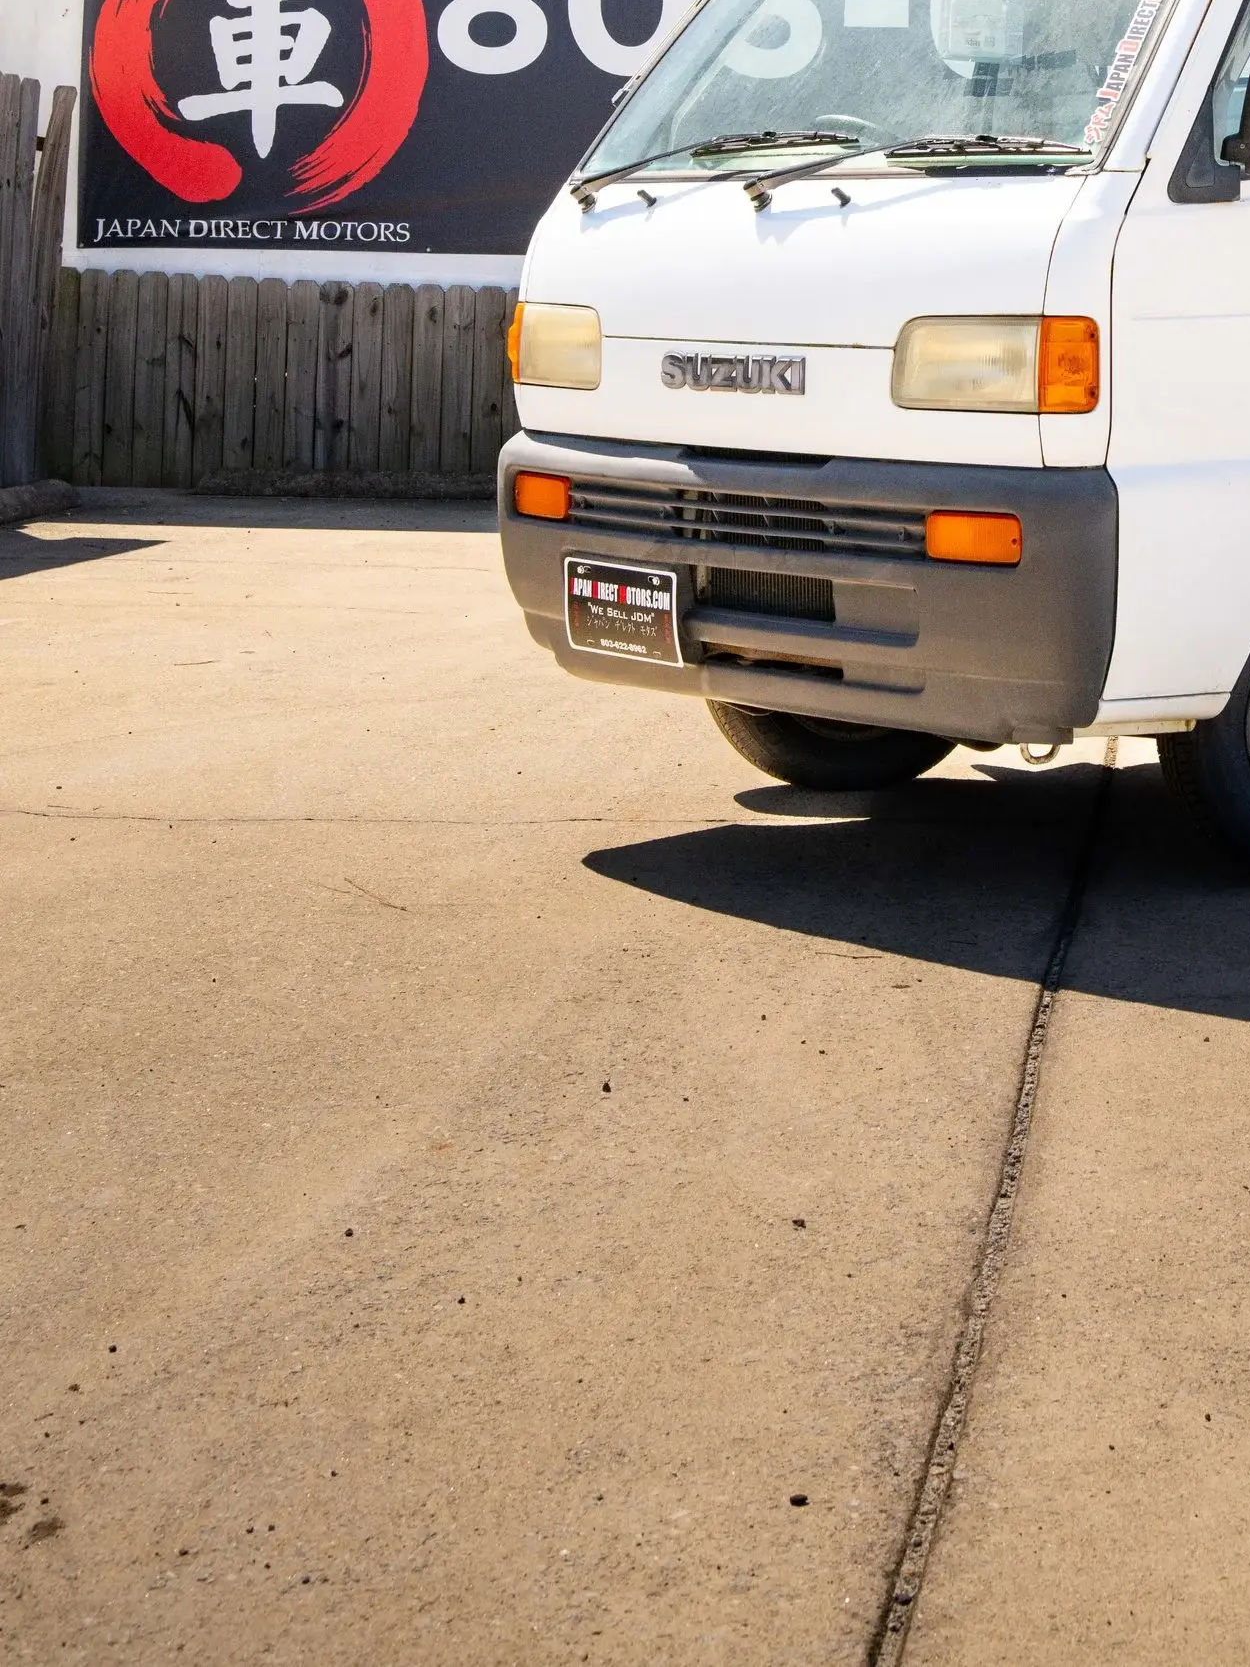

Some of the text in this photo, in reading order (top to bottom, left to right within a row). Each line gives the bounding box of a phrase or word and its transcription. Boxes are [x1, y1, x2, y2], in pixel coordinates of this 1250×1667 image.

[93, 218, 410, 243] JAPAN DIRECT MOTORS
[660, 350, 807, 396] SUZUKI
[606, 607, 629, 620] SELL
